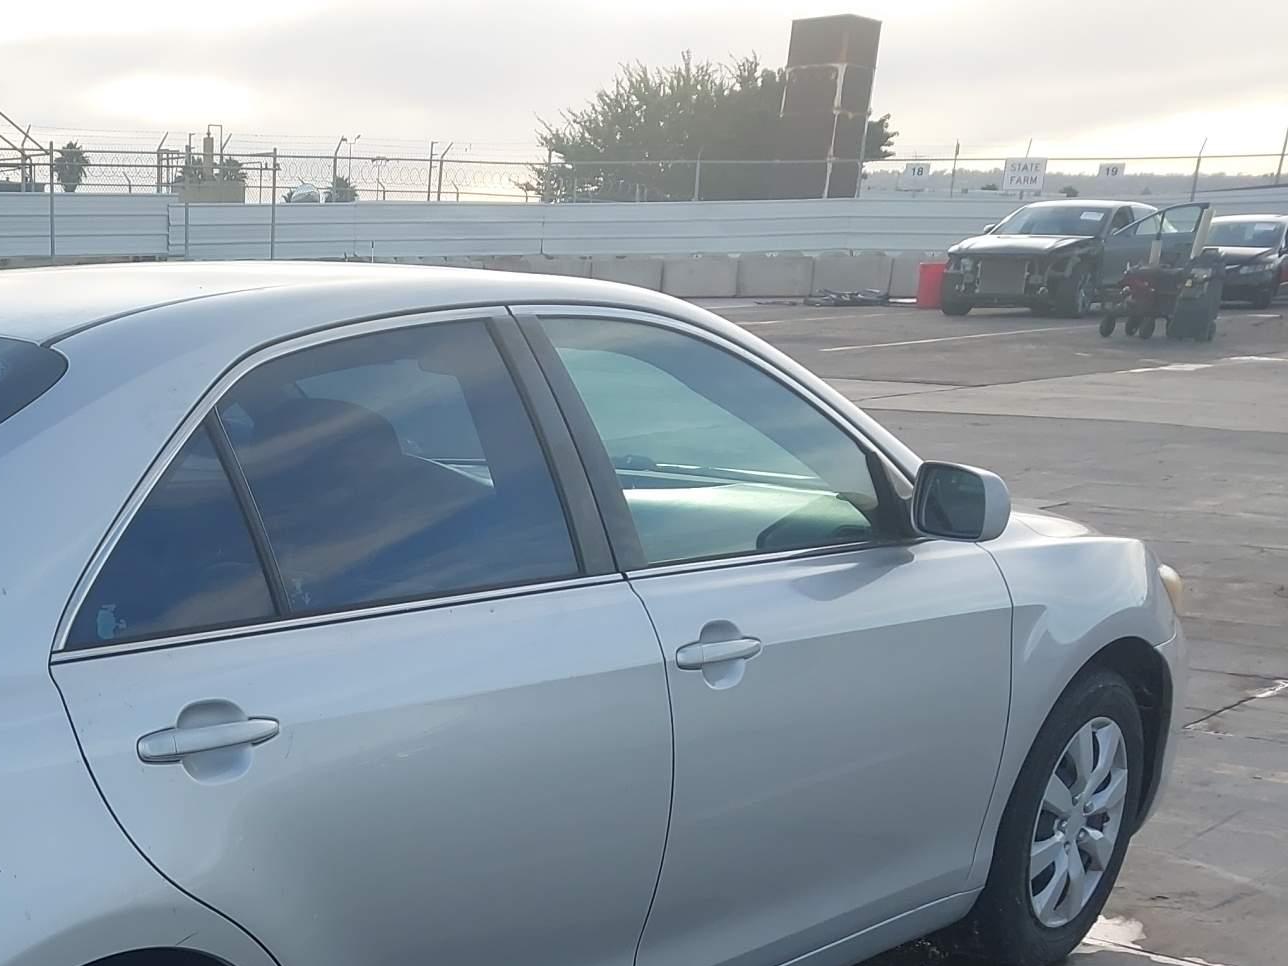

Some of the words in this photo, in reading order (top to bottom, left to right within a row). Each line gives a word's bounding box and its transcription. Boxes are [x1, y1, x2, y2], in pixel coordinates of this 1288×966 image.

[911, 166, 925, 176] 18
[1010, 162, 1041, 172] STATE
[1106, 167, 1119, 176] 19
[1009, 175, 1038, 185] FARM
